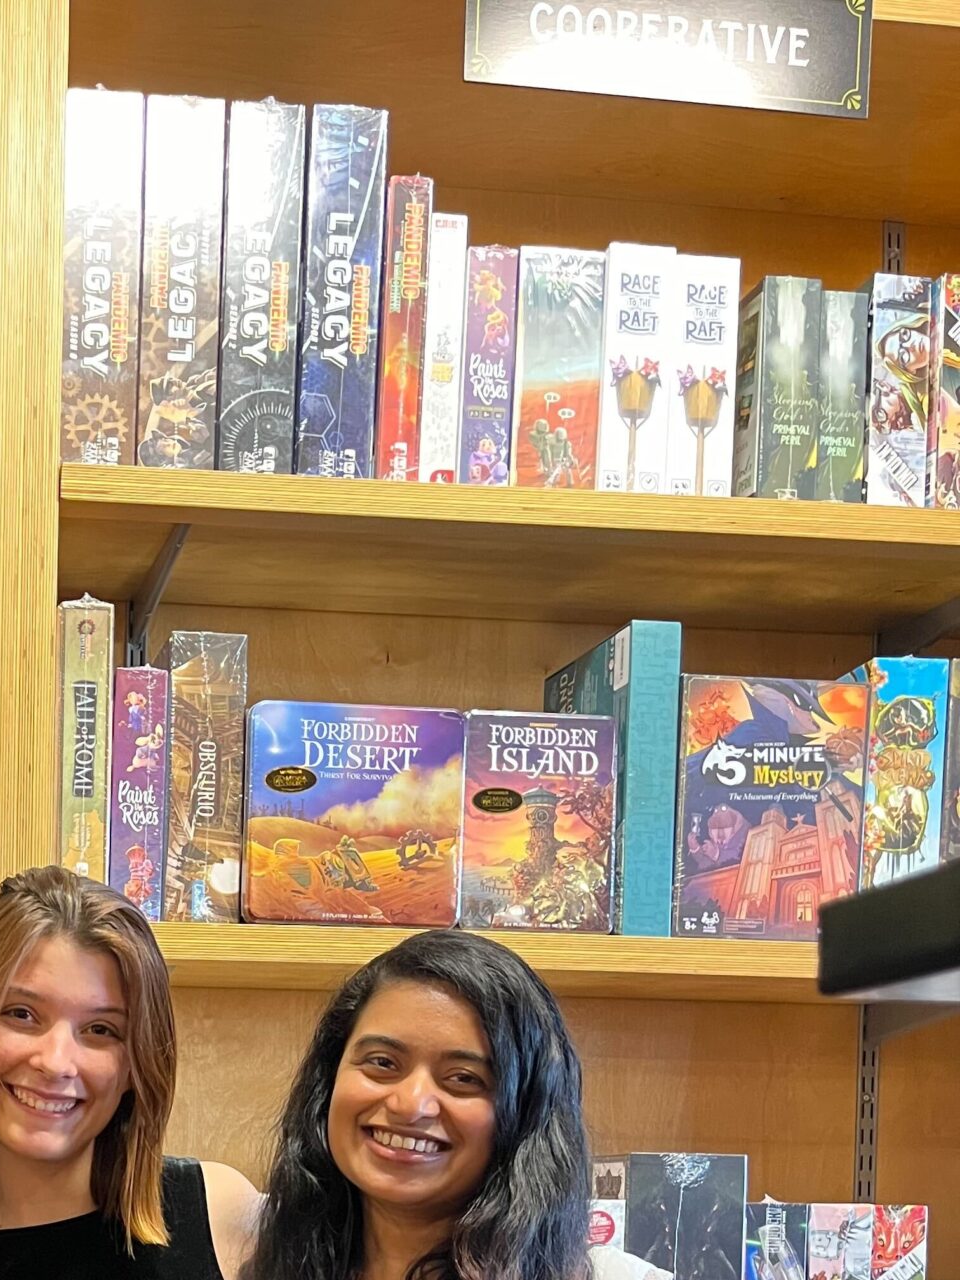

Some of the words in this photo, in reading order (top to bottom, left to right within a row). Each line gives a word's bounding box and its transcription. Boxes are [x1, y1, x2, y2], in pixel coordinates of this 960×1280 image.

[529, 3, 810, 67] COOPERATIVE
[402, 203, 425, 299] PANDEMIC
[321, 212, 355, 369] LEGACY
[620, 272, 661, 295] RACE
[687, 283, 727, 305] RACE
[80, 217, 113, 383] LEGACY
[239, 230, 272, 367] EGACY
[269, 261, 290, 352] PANDEMIC
[350, 264, 371, 355] PANDEMIC
[110, 271, 129, 363] PANDEMIC
[619, 310, 659, 332] RAFT
[685, 320, 725, 342] RAFT
[469, 353, 506, 378] Paint
[470, 376, 509, 405] Roses
[772, 424, 811, 436] PRIMEVAL
[780, 435, 802, 446] PERIL
[819, 435, 855, 448] PRIMEVAL
[826, 446, 848, 458] PERIL
[72, 683, 97, 724] FALL
[300, 718, 420, 744] FORBIDDEN
[488, 724, 598, 748] FORBIDDEN
[72, 734, 97, 797] ROME
[301, 739, 420, 773] DESERT
[487, 743, 599, 779] ISLAND
[196, 741, 217, 818] OBSCURIO
[318, 770, 345, 779] THIRST
[346, 771, 361, 780] FOR
[362, 772, 394, 781] SURVIVA
[753, 765, 825, 789] Mystery
[118, 780, 156, 805] Paint
[729, 792, 742, 800] The
[774, 793, 783, 802] of
[781, 793, 818, 802] Everything
[119, 803, 159, 832] Roses
[684, 920, 697, 930] 8+
